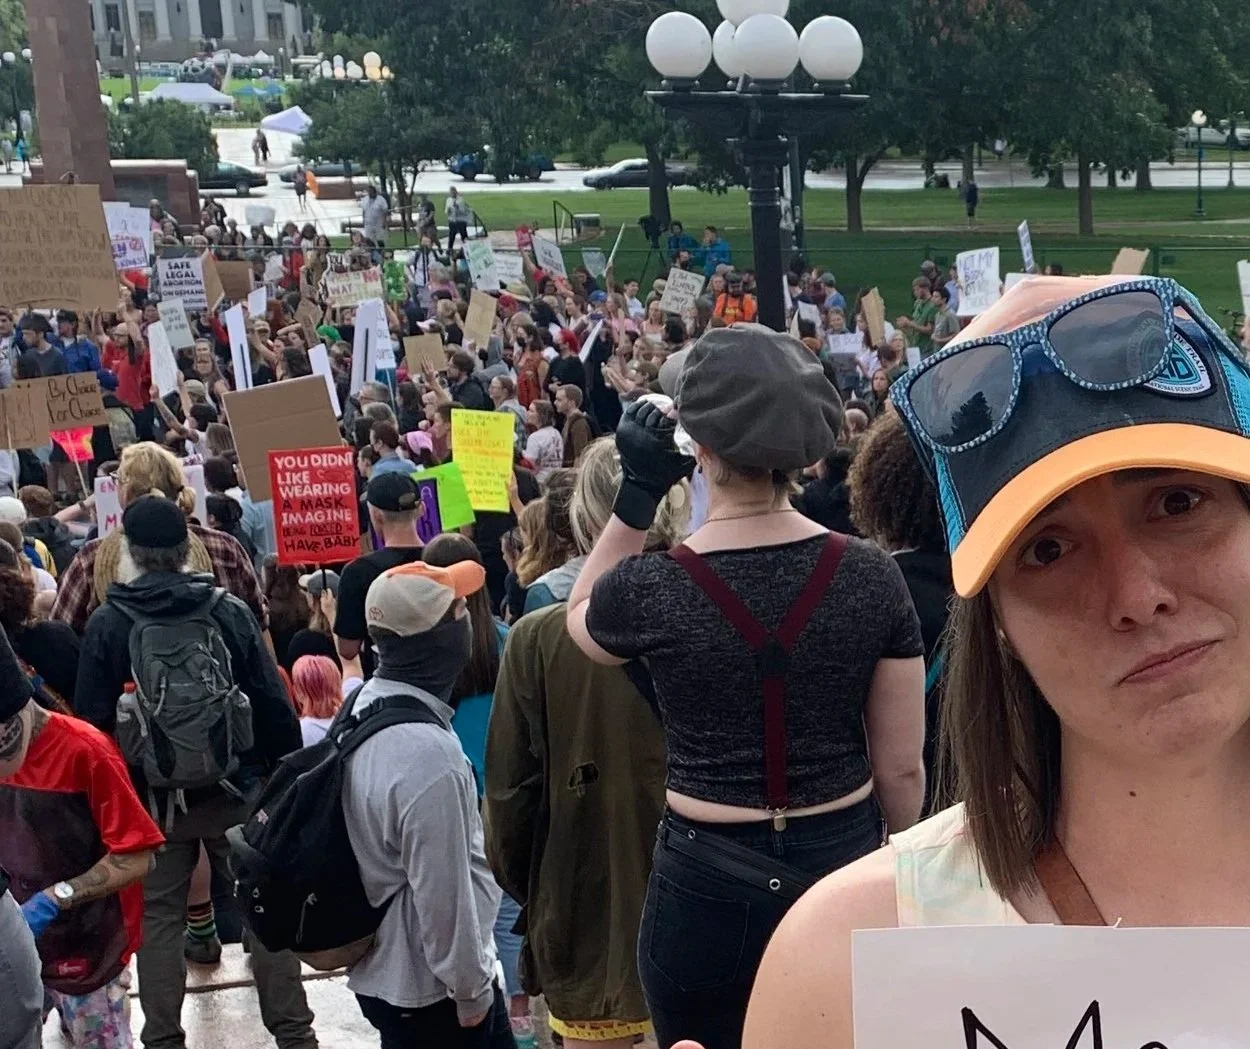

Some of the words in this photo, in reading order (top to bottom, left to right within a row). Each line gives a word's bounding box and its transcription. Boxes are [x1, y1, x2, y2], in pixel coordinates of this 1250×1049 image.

[167, 261, 191, 270] SAFE
[165, 270, 196, 280] LEGAL
[274, 455, 309, 469] YOU
[277, 470, 310, 485] LIKE
[279, 483, 351, 498] WEARING
[282, 500, 293, 511] A
[281, 508, 353, 526] IMAGINE
[284, 539, 321, 553] HAVE
[324, 536, 360, 549] BABY
